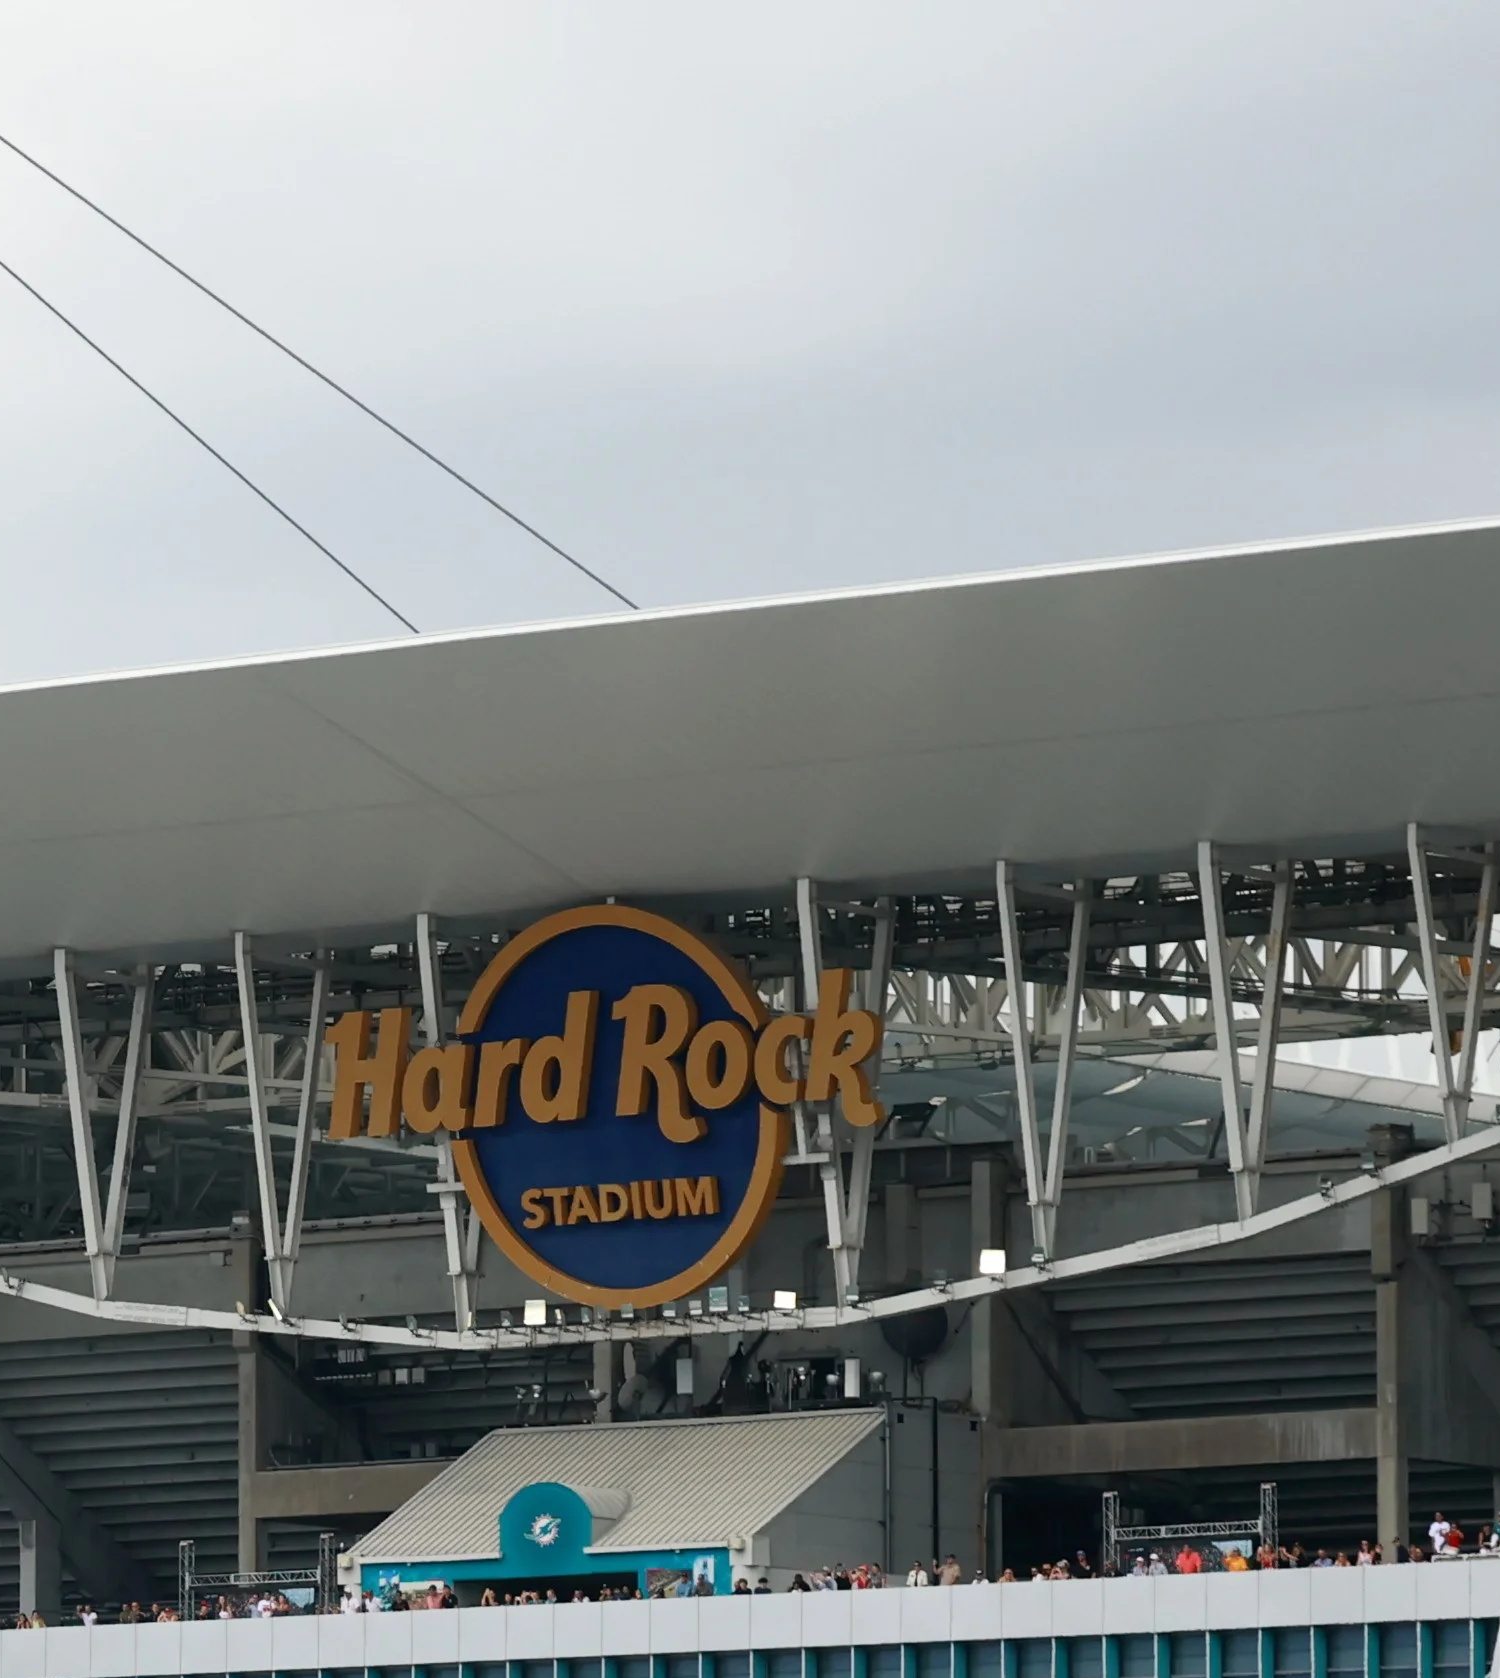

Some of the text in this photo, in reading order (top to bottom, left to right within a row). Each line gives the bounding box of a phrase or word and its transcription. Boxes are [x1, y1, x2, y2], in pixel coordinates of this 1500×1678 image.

[325, 967, 886, 1144] Hard Rock
[521, 1175, 720, 1230] STADIUM
